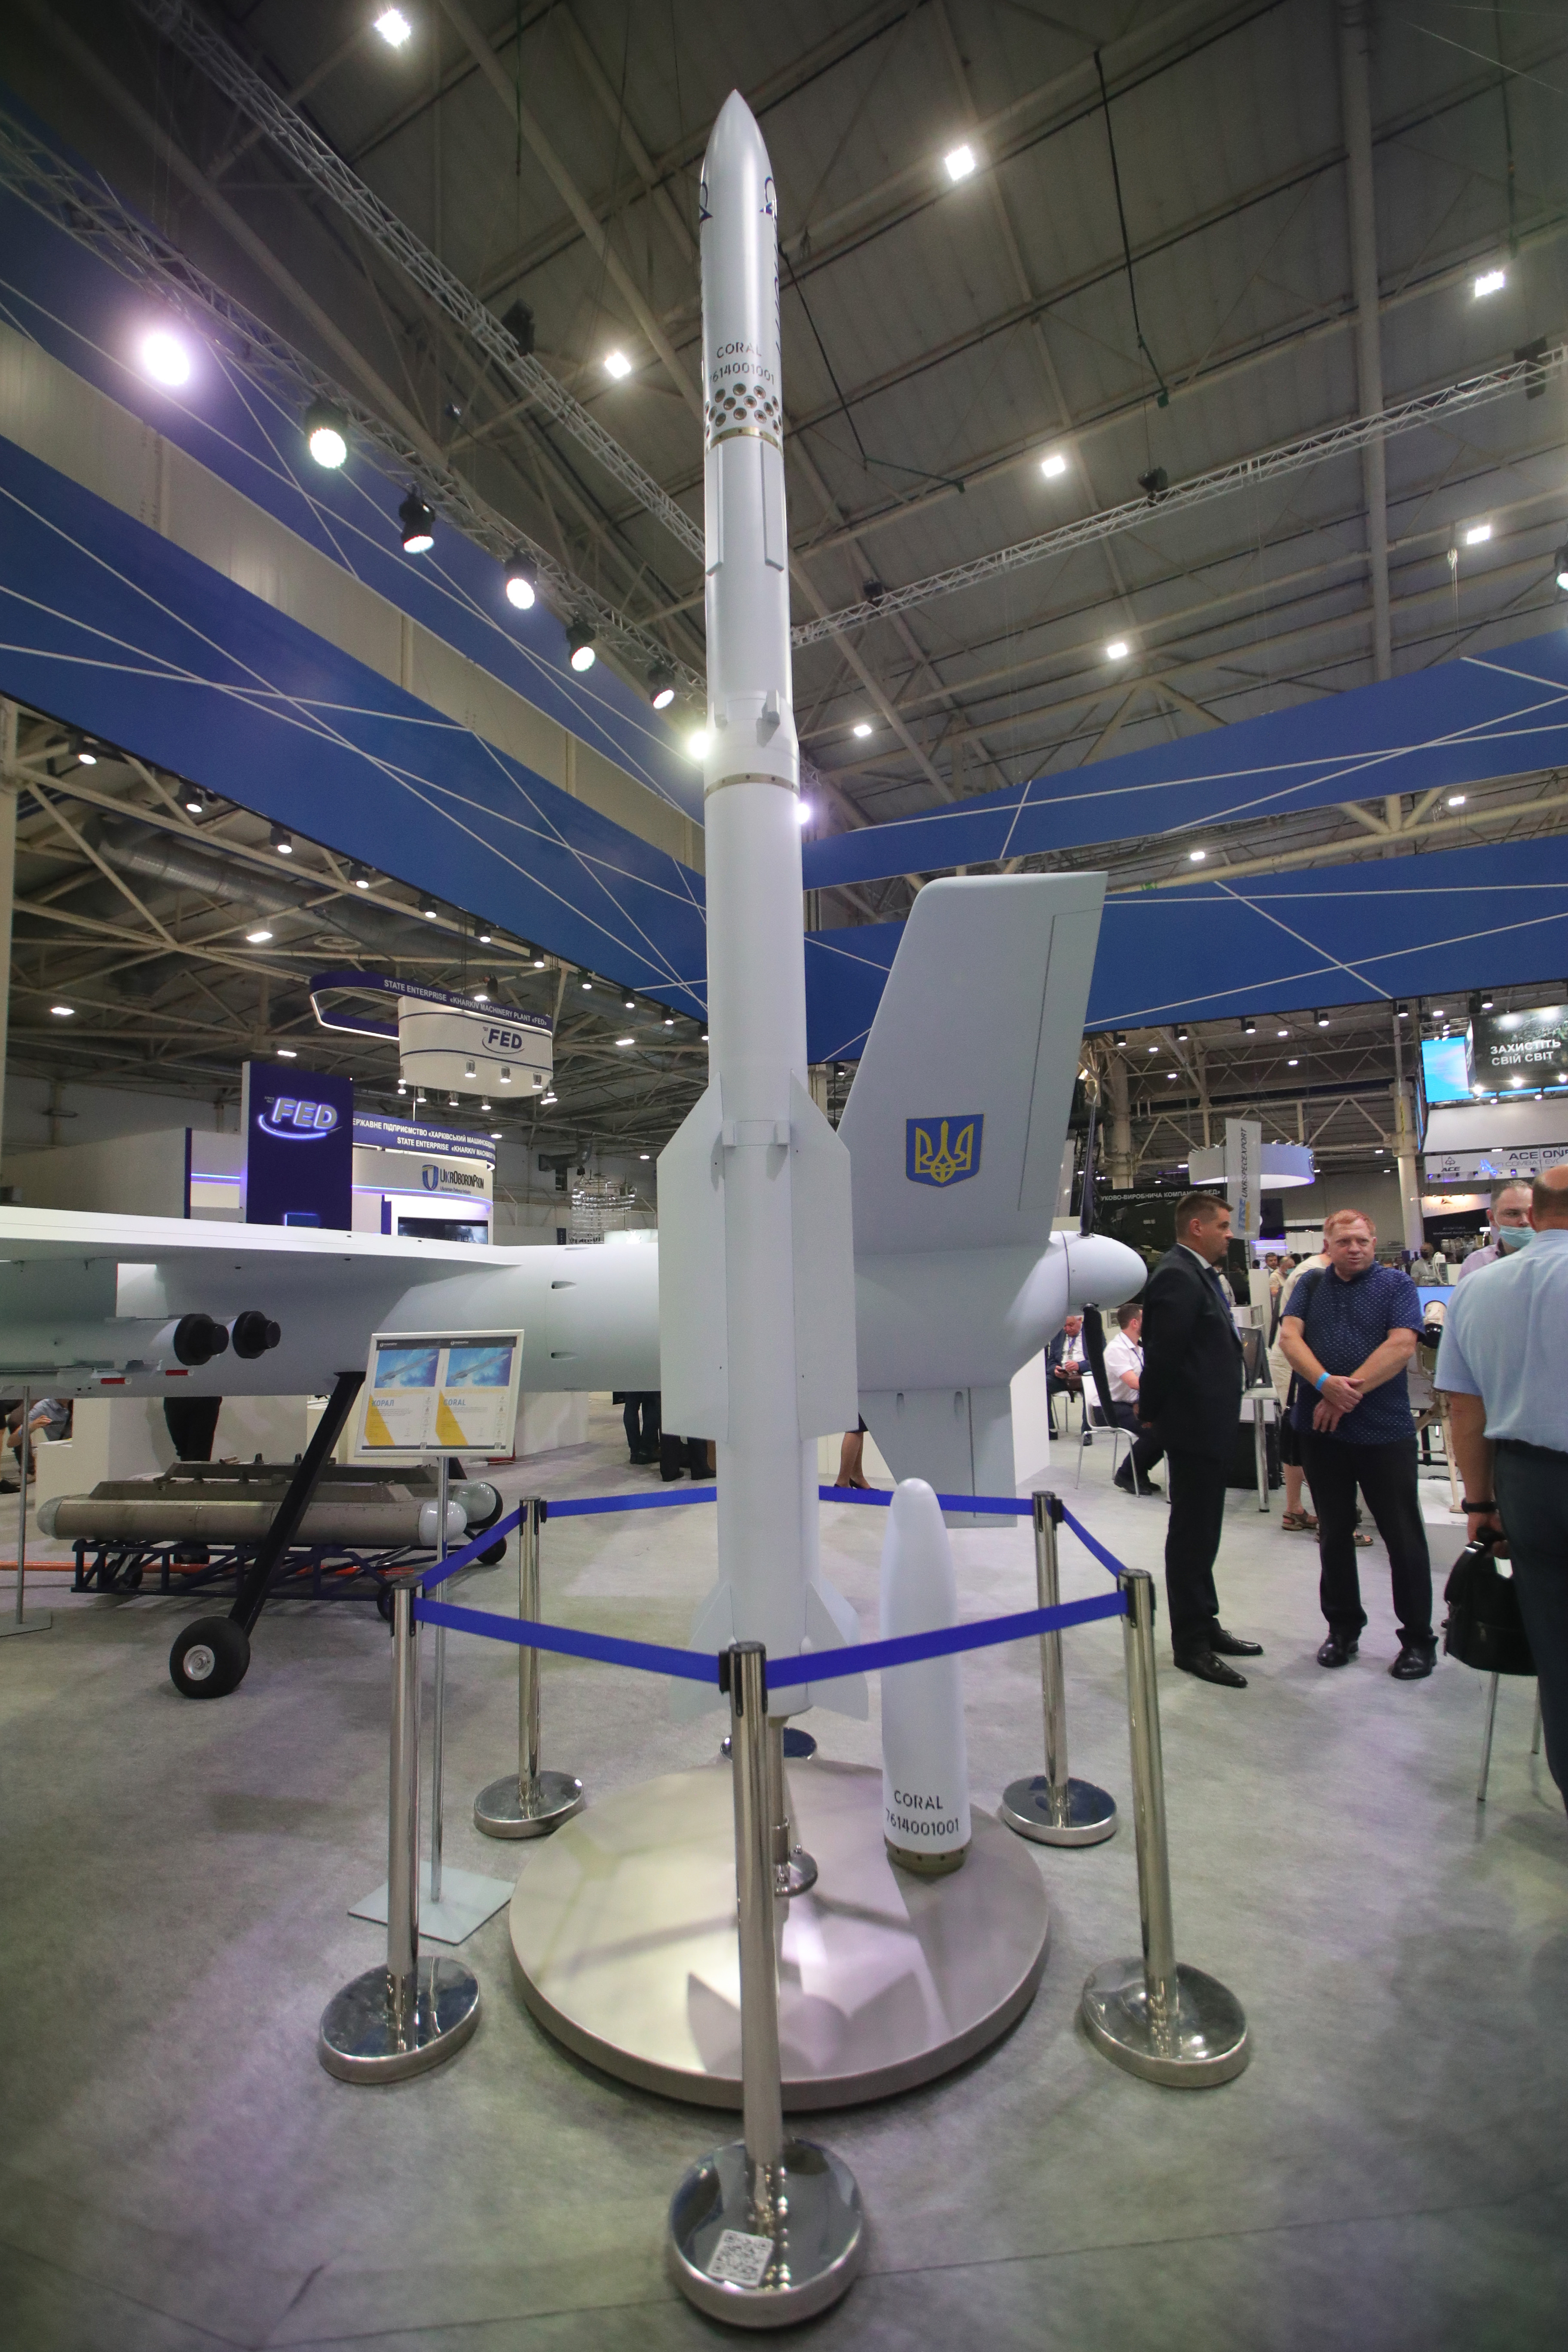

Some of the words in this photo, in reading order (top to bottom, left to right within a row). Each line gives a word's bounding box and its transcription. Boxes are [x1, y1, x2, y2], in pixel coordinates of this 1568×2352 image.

[717, 342, 762, 358] CORAL
[384, 979, 405, 991] STATE
[407, 985, 447, 1001] ENTERPRISE
[450, 996, 480, 1009] «KHARKIV
[480, 1004, 513, 1017] MACHINERY
[514, 1011, 531, 1022] PLANT
[488, 1028, 522, 1049] FED
[1490, 1039, 1561, 1054] ЗАХИСТІТЬ
[1491, 1054, 1521, 1066] СВІЙ
[1525, 1051, 1554, 1062] СВІТ
[272, 1097, 338, 1130] FED
[353, 1118, 382, 1129] ЕРЖАВНЕ
[383, 1122, 427, 1136] ПІДПРИЄМСТВО
[397, 1137, 415, 1145] STATE
[416, 1139, 449, 1151] ENTERPRISE
[1509, 1152, 1538, 1160] ACE
[1101, 1192, 1163, 1200] УКОВО-ВИРОБНИЧА
[894, 1789, 943, 1810] CORAL
